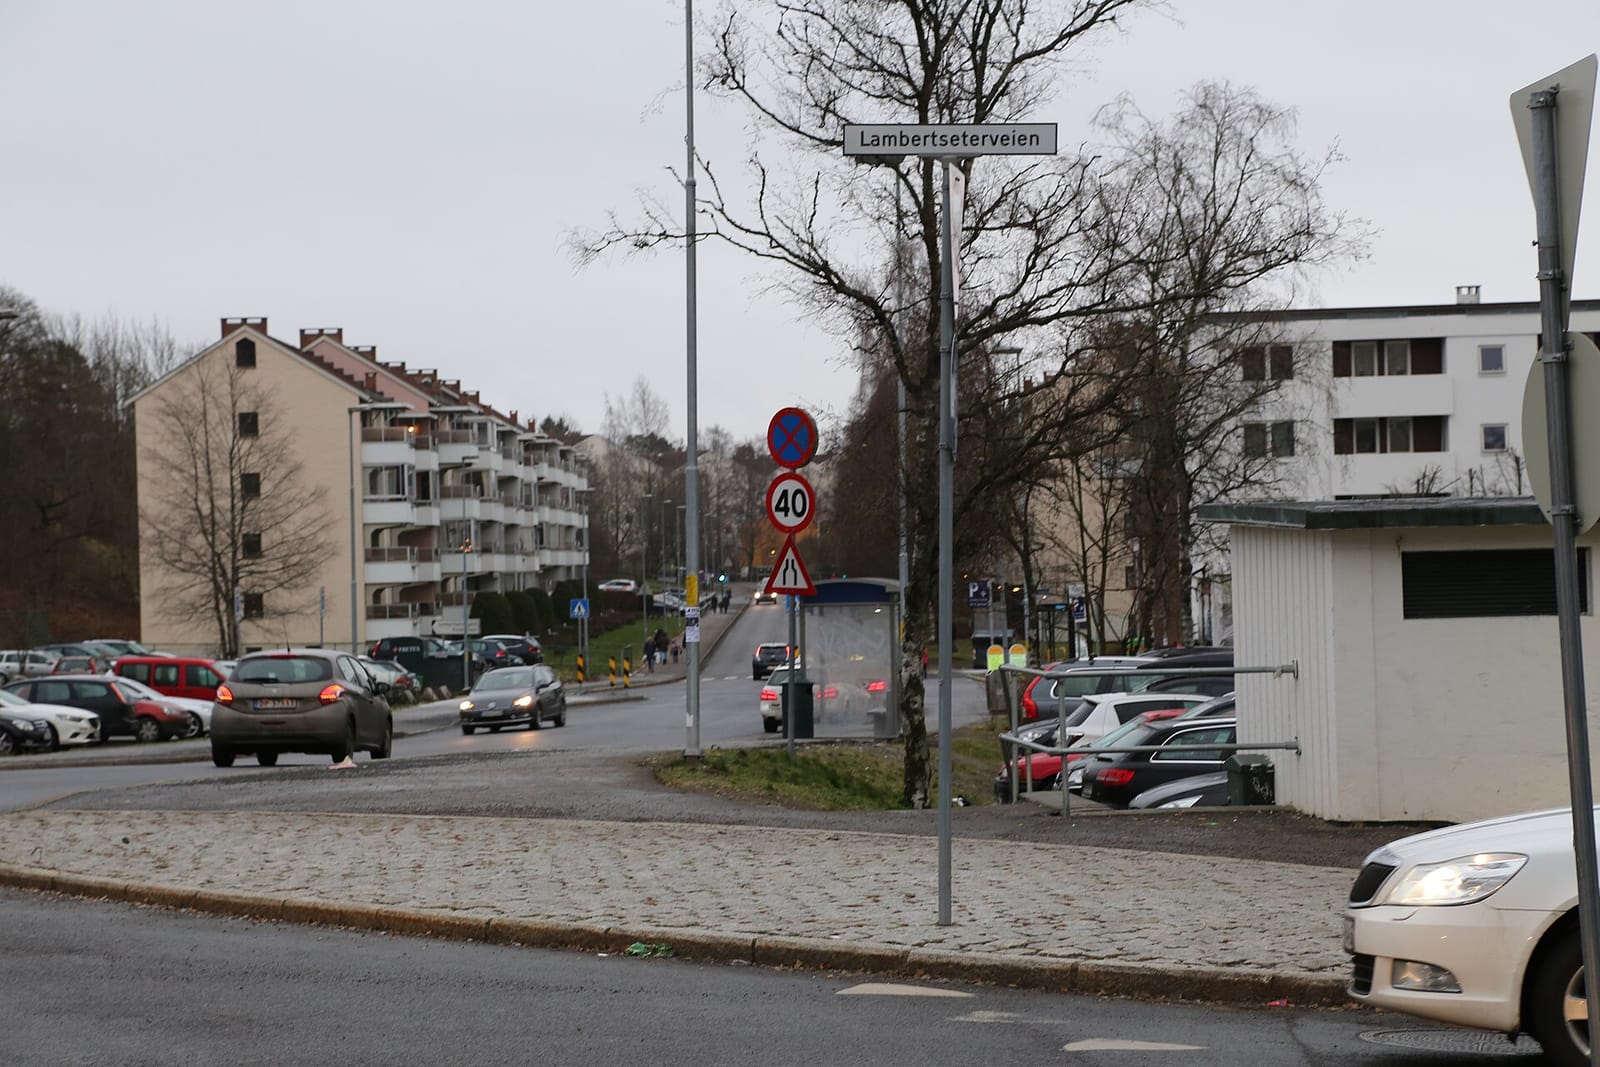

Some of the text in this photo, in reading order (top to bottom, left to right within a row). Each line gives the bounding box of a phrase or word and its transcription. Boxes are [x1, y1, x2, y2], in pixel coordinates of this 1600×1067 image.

[860, 130, 1040, 147] Lambertseterveien
[775, 489, 807, 518] 40
[969, 582, 979, 597] P
